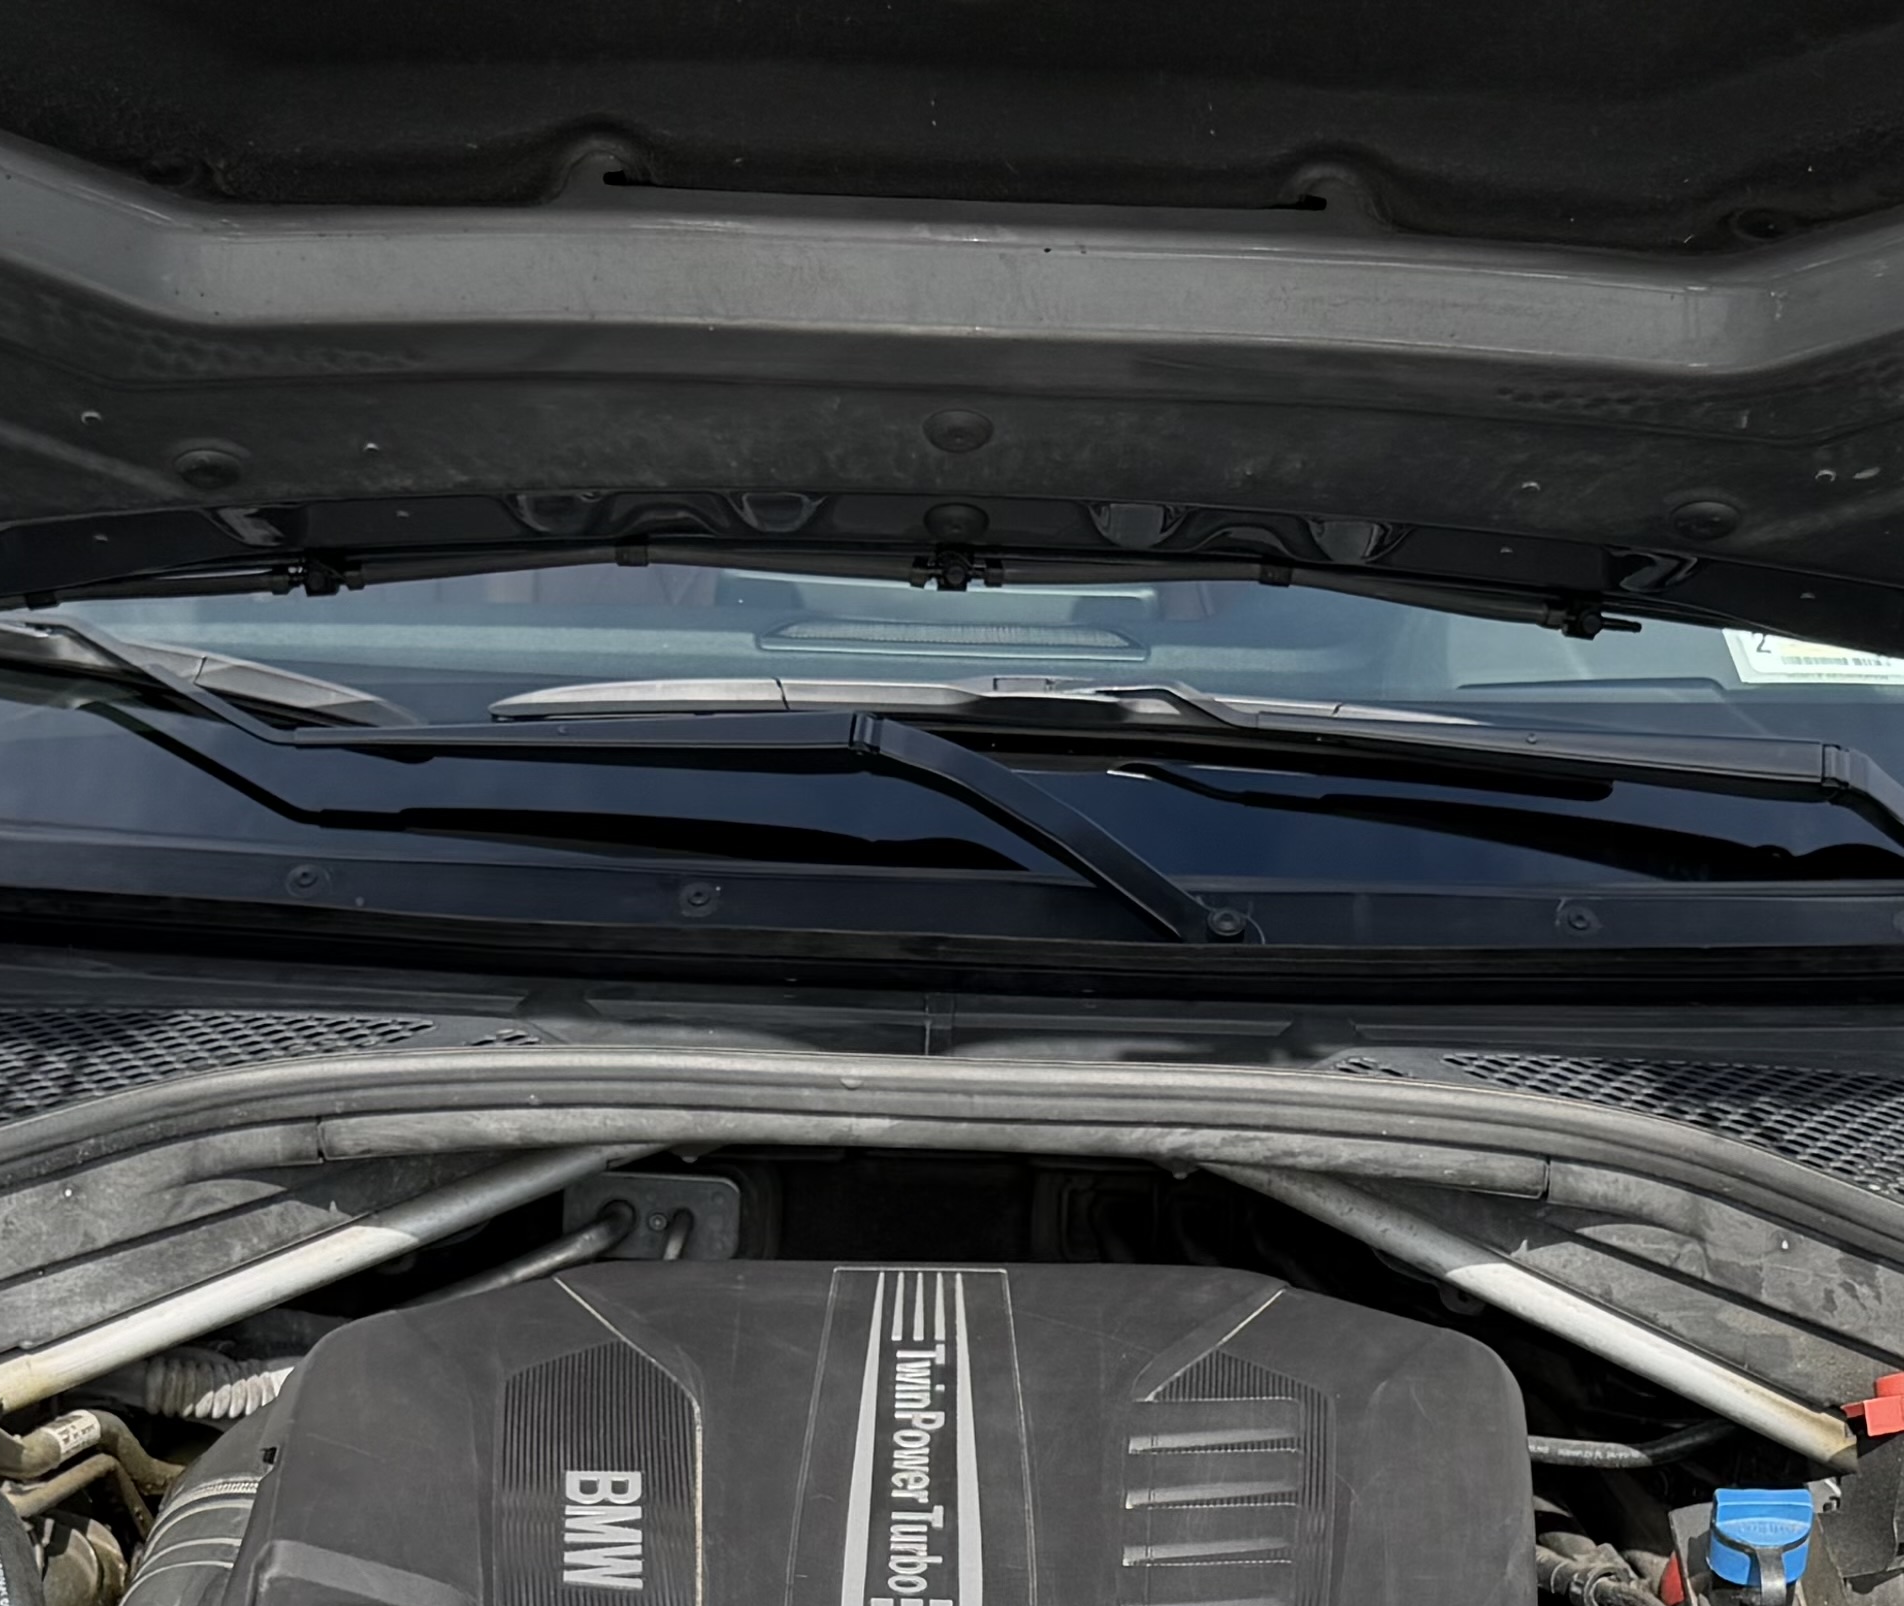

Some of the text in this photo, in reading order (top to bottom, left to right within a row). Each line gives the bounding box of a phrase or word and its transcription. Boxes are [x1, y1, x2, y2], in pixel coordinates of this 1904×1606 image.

[563, 1470, 644, 1590] BMW
[887, 1344, 946, 1595] TwinPower Turbo
